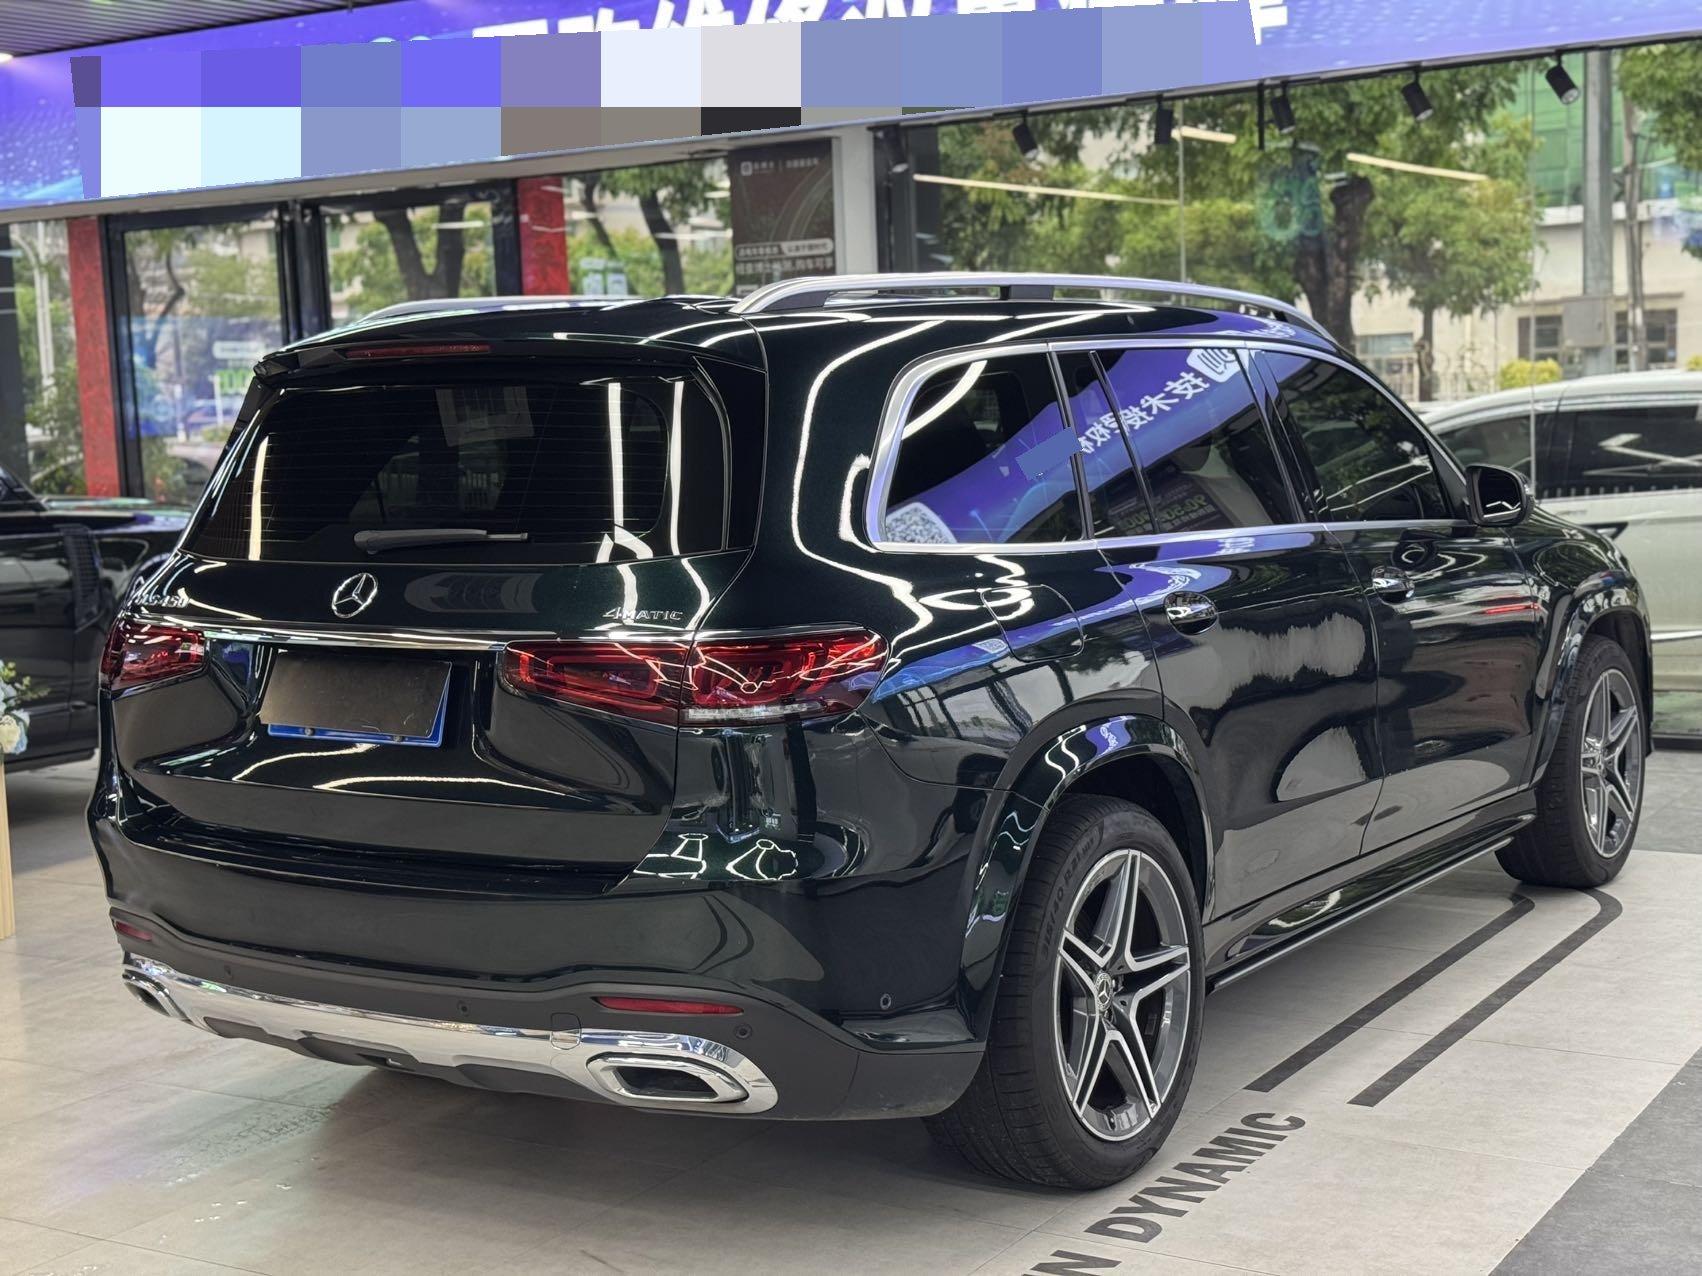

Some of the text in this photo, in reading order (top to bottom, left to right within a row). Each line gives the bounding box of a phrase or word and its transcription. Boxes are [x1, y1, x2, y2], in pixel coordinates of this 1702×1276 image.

[602, 606, 684, 621] 4MATIC
[1020, 1112, 1306, 1276] N DYNAMIC
